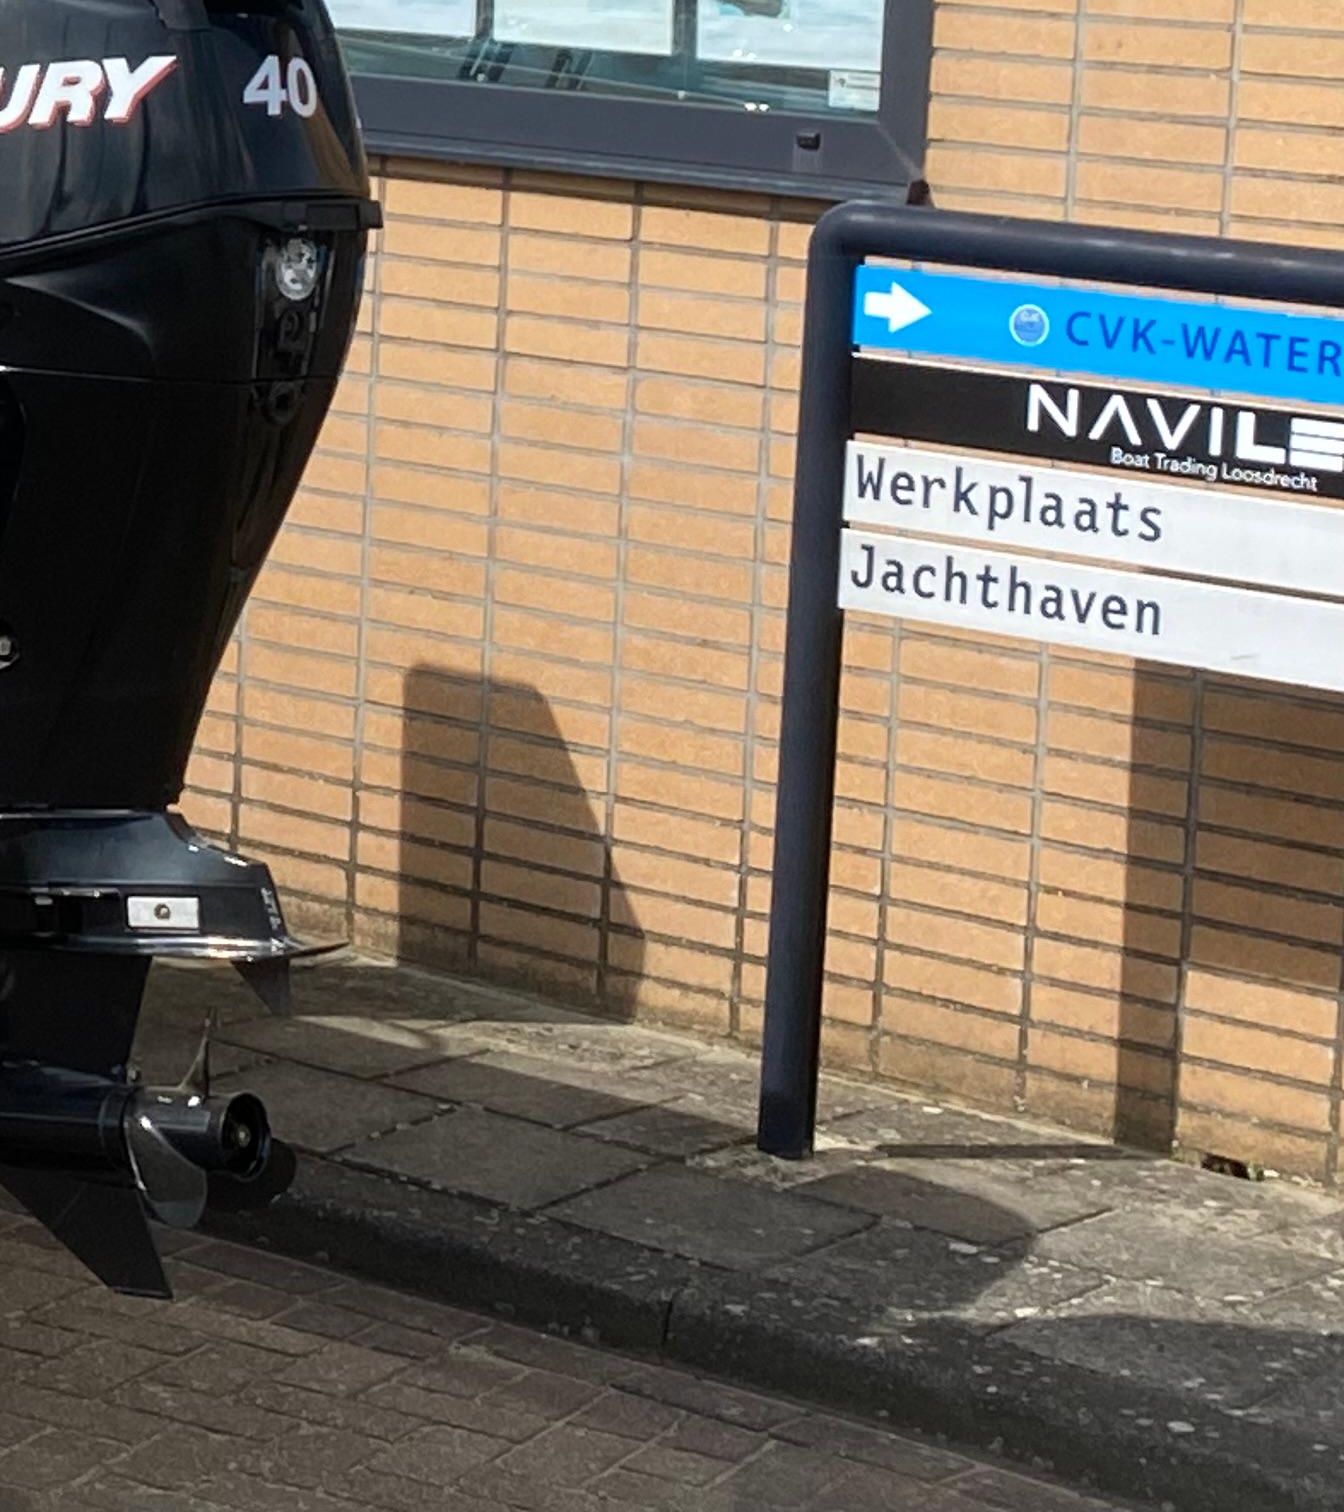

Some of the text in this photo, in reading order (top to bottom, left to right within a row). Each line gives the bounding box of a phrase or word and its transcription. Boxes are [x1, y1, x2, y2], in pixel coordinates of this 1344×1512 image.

[243, 54, 318, 118] 40
[1065, 310, 1342, 377] CVK-WATER
[855, 454, 1164, 543] Werkplaats
[1111, 446, 1318, 491] Boat Trading Loosdrecht
[850, 544, 1163, 636] Jachthaven
